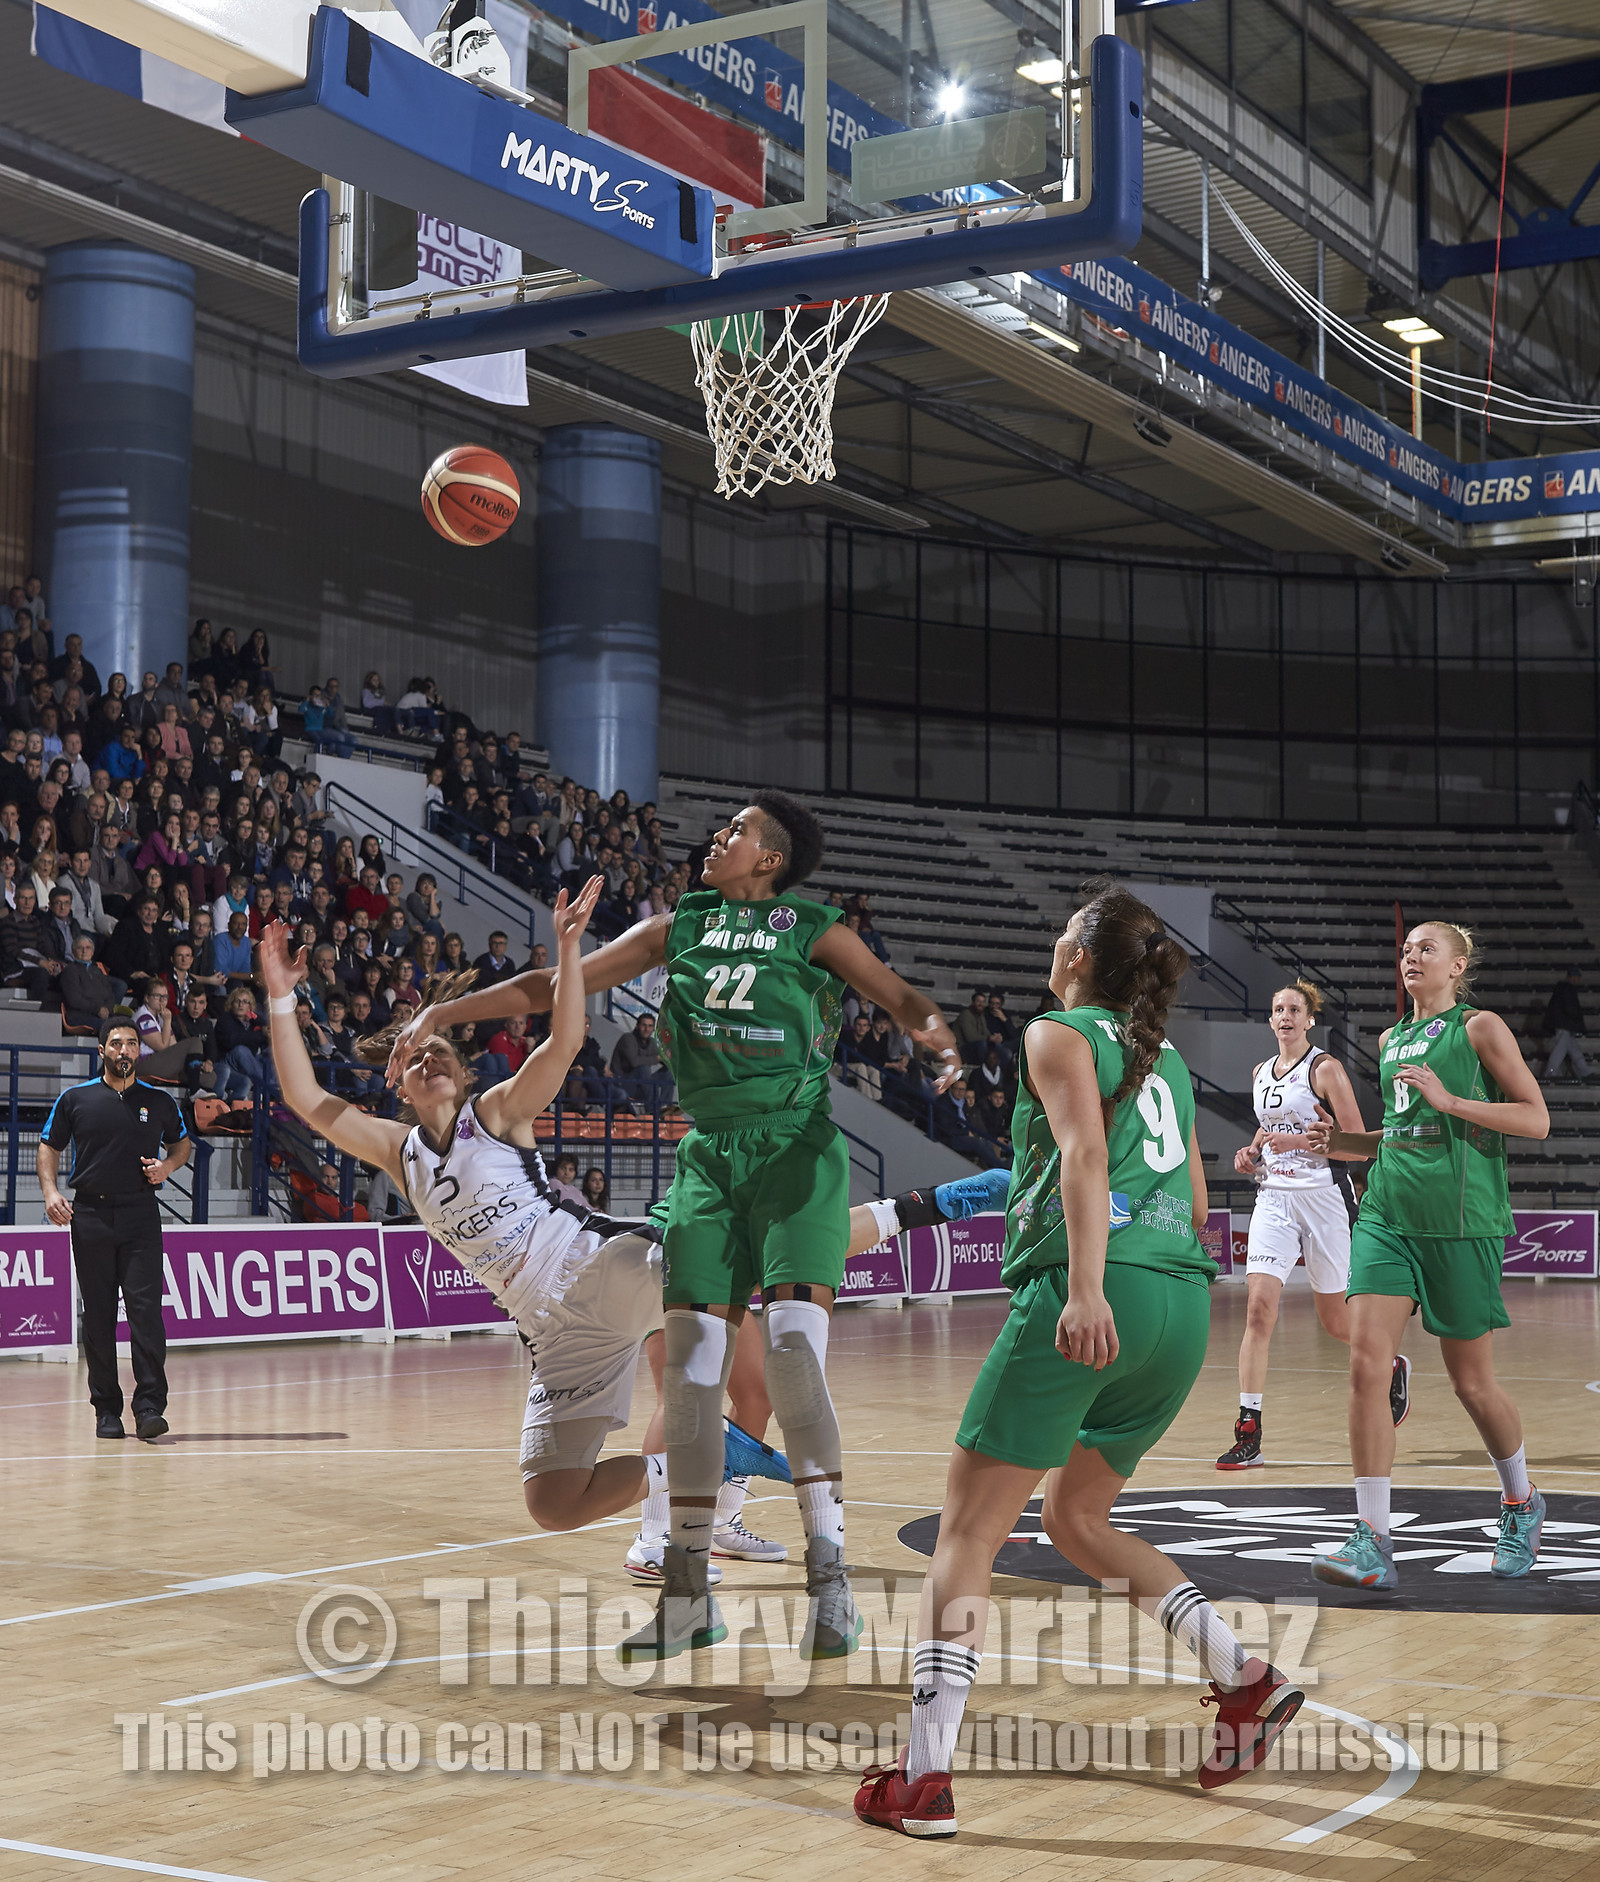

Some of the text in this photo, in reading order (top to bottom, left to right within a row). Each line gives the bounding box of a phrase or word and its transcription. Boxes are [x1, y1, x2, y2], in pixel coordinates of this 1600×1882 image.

[501, 131, 612, 203] MARTY
[1072, 260, 1133, 312] ANGERS
[1151, 299, 1210, 357] ANGERS
[1219, 341, 1271, 394] ANGERS
[1285, 380, 1332, 430] ANGERS
[1343, 414, 1386, 461] ANGERS
[1398, 447, 1440, 491] ANGERS
[1449, 474, 1533, 507] ANGERS
[469, 494, 515, 521] molten
[704, 963, 757, 1010] 22
[1262, 1085, 1285, 1109] 15
[1393, 1078, 1409, 1114] 8
[1137, 1073, 1187, 1174] 9
[433, 1163, 461, 1206] 5
[953, 1242, 1005, 1264] PAYS DE L
